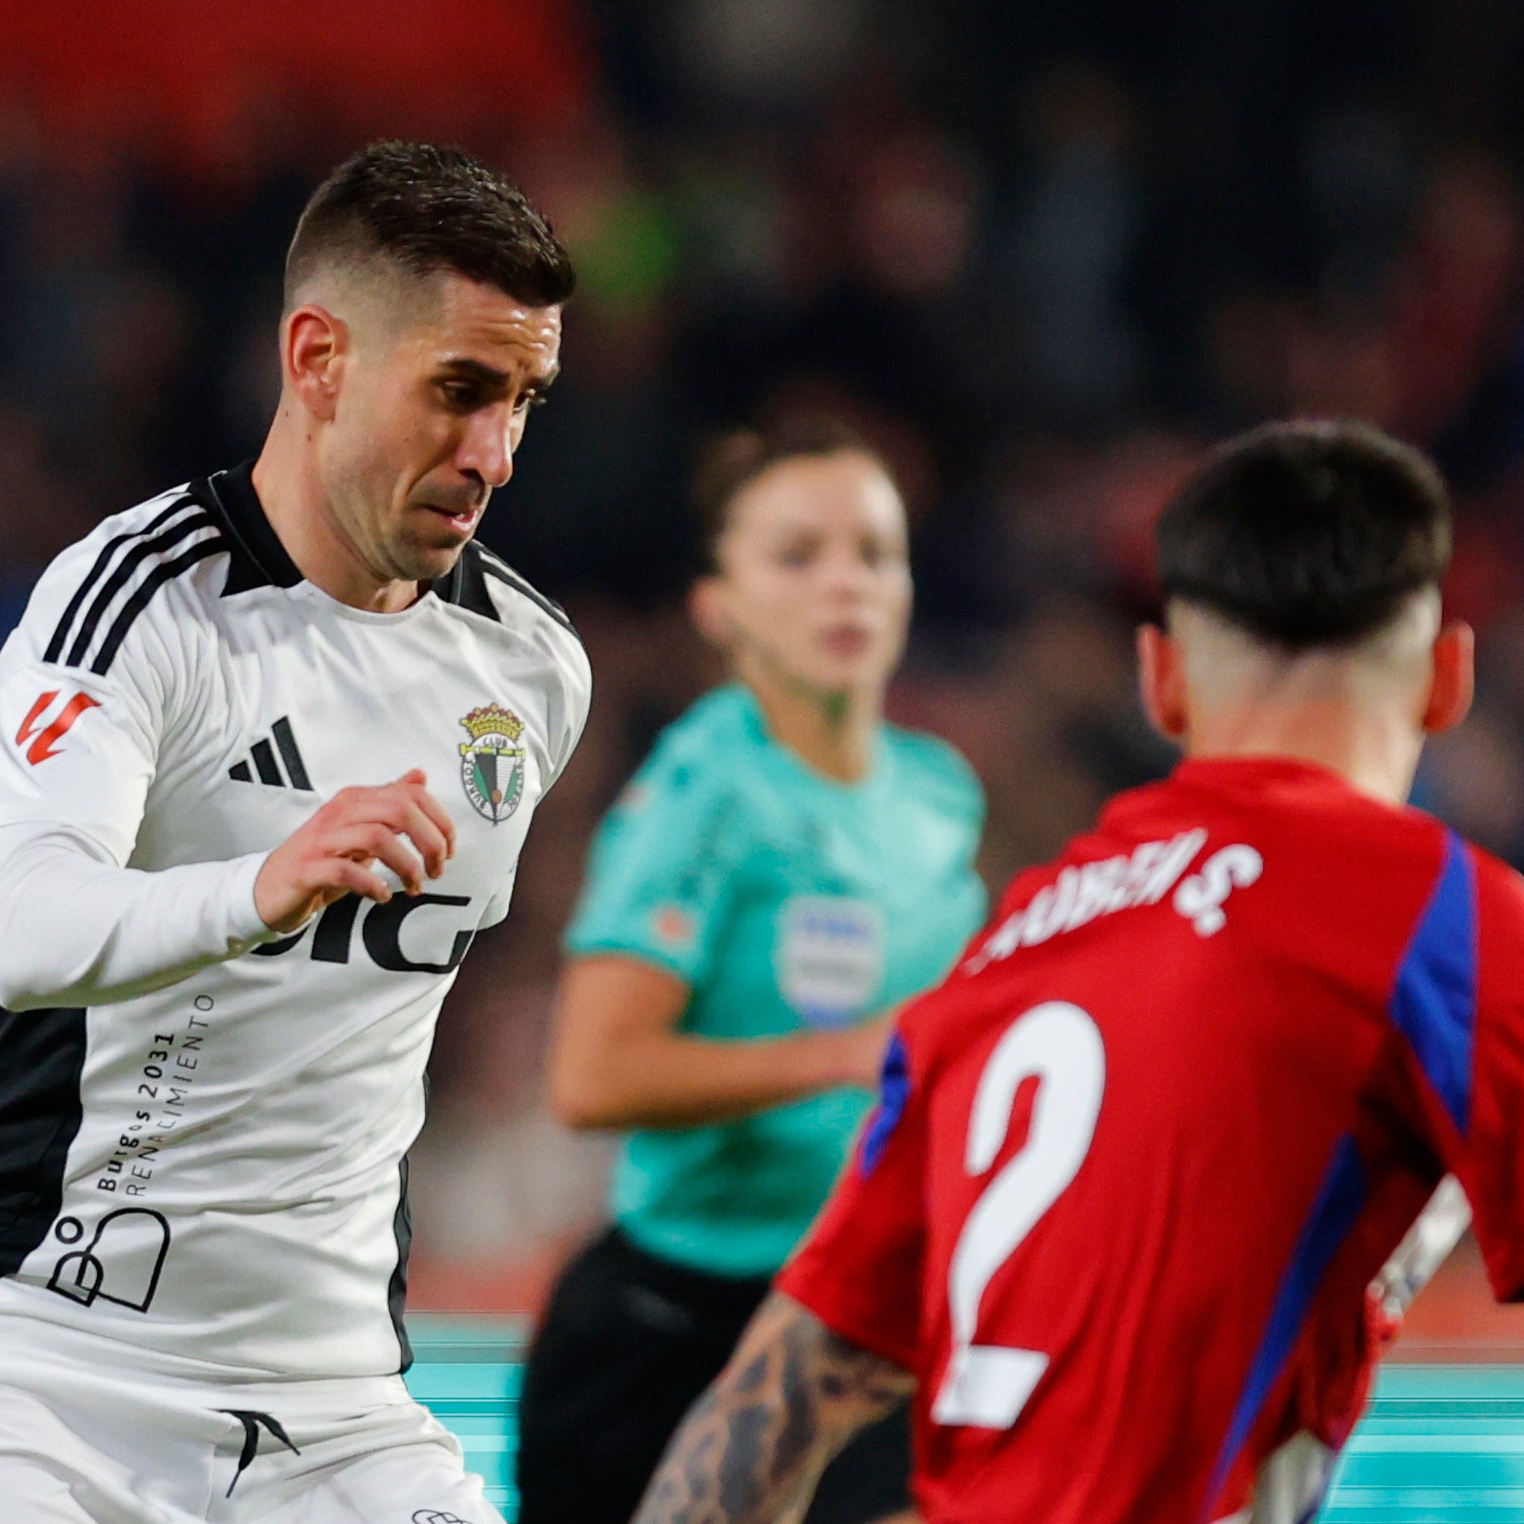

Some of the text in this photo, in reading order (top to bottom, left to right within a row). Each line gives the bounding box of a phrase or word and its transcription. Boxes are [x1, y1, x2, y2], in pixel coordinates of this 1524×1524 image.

[1173, 842, 1265, 938] S.
[97, 1033, 175, 1194] Burgos 2031
[125, 993, 216, 1198] RENACIMIENTO
[930, 1000, 1107, 1431] 2
